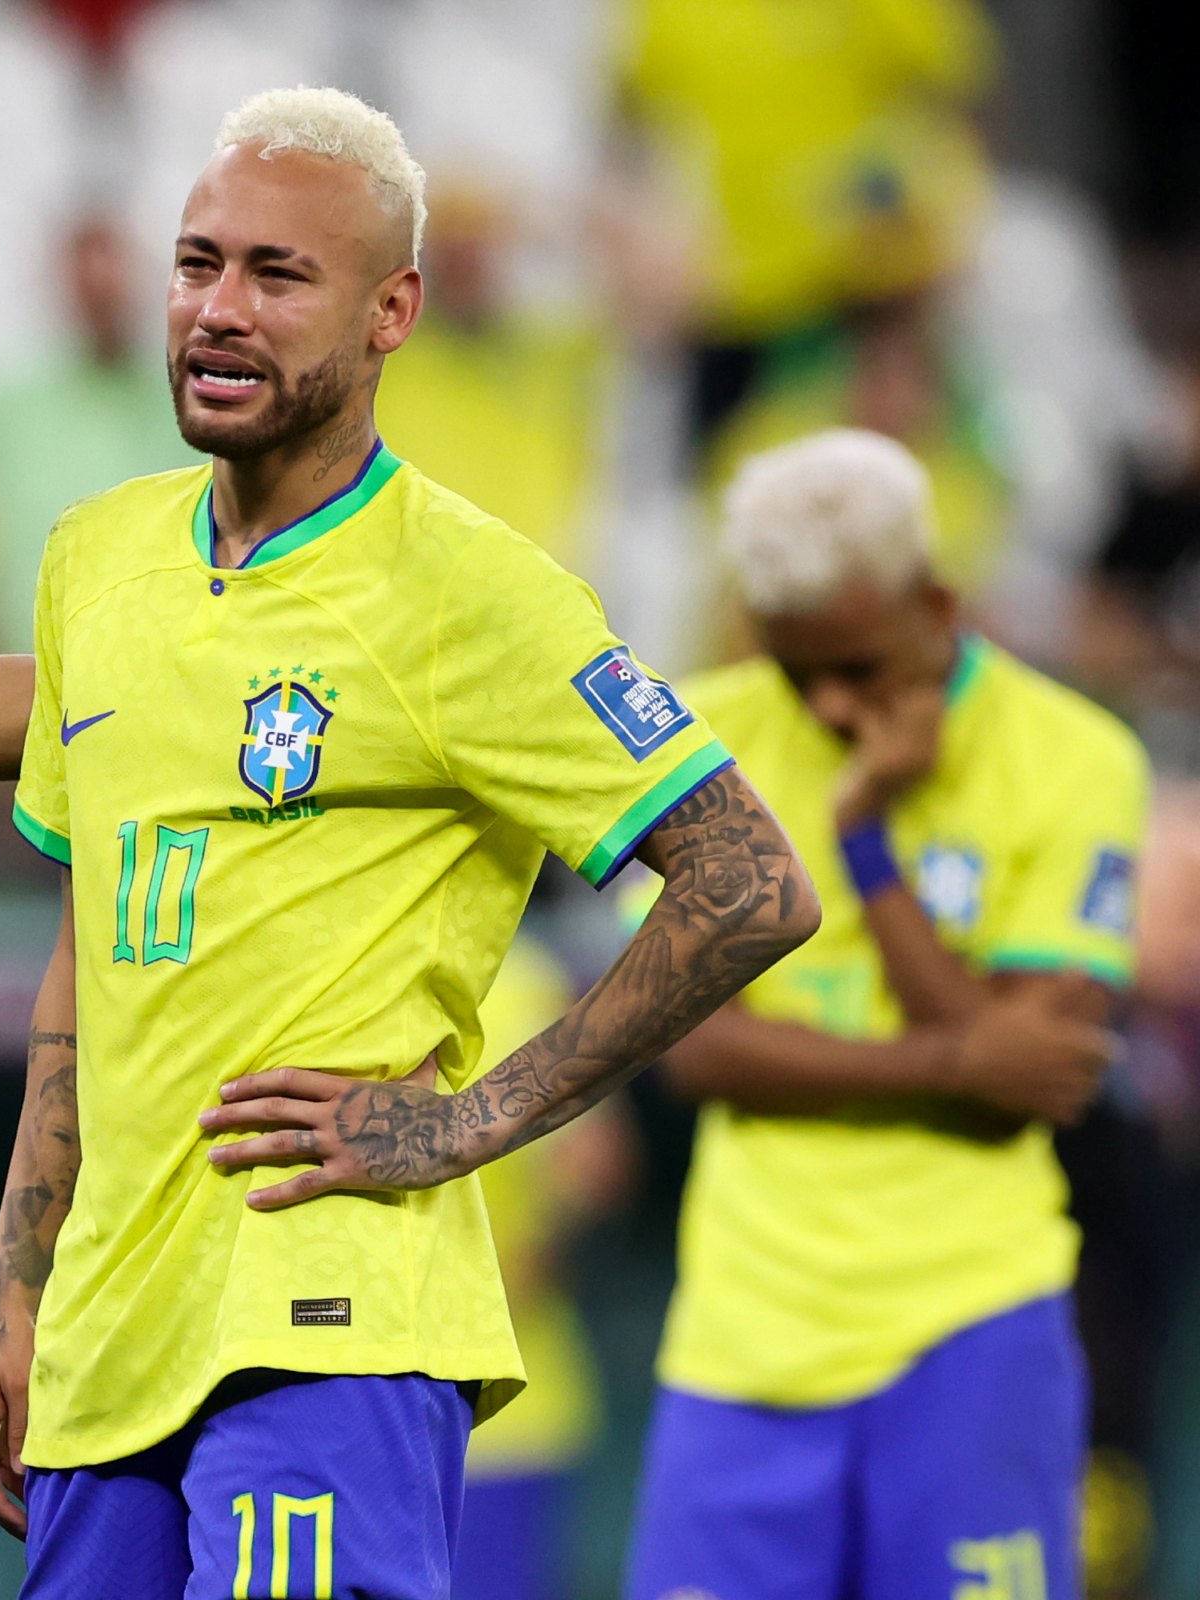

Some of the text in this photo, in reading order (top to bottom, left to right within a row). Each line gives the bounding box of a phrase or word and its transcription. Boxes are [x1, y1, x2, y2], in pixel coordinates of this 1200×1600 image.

[265, 731, 298, 748] CBF
[229, 796, 325, 824] BRASIL
[112, 820, 210, 967] 10
[232, 1491, 334, 1600] 10
